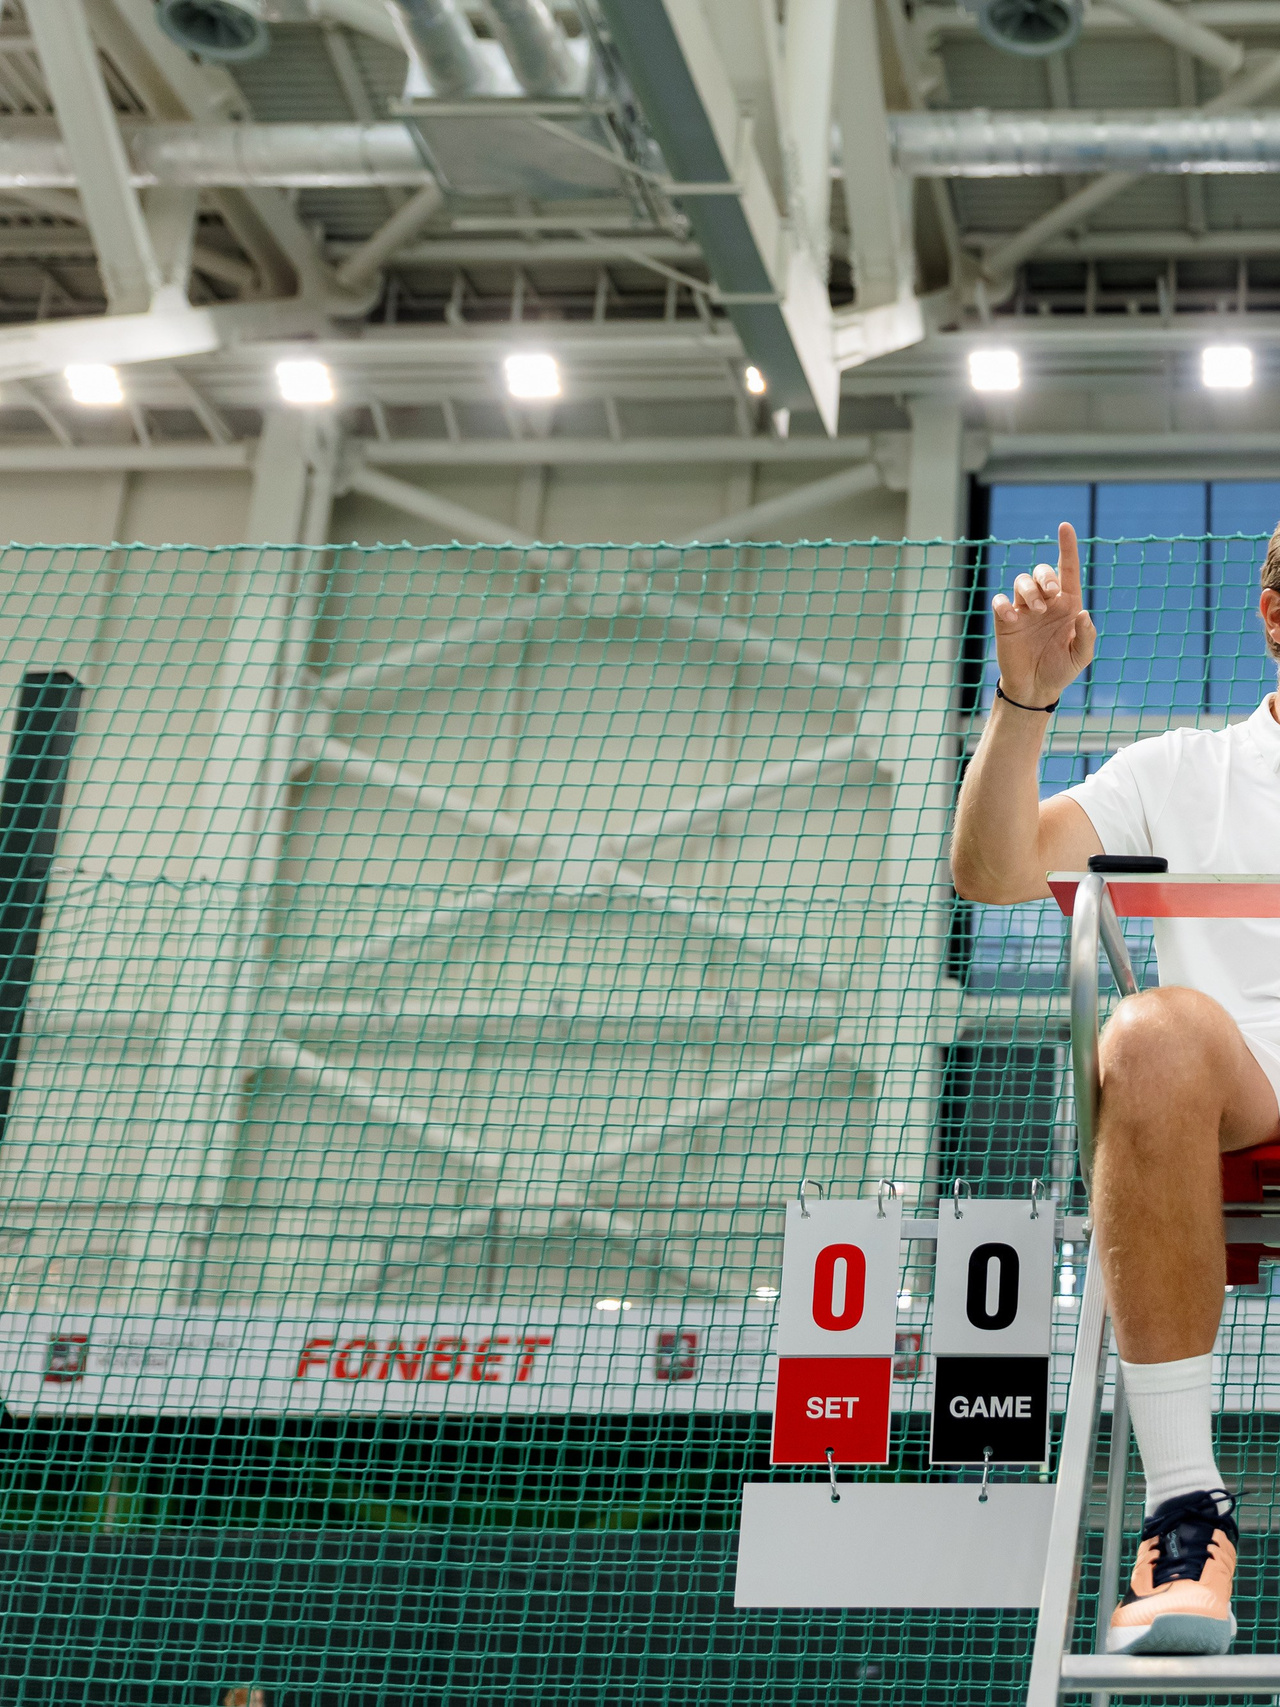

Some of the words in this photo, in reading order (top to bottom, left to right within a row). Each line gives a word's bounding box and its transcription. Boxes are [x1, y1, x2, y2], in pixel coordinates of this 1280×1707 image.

[812, 1243, 866, 1332] 0
[966, 1242, 1019, 1330] 0
[295, 1336, 552, 1382] FONBET
[806, 1397, 859, 1418] SET
[949, 1396, 1032, 1418] GAME
